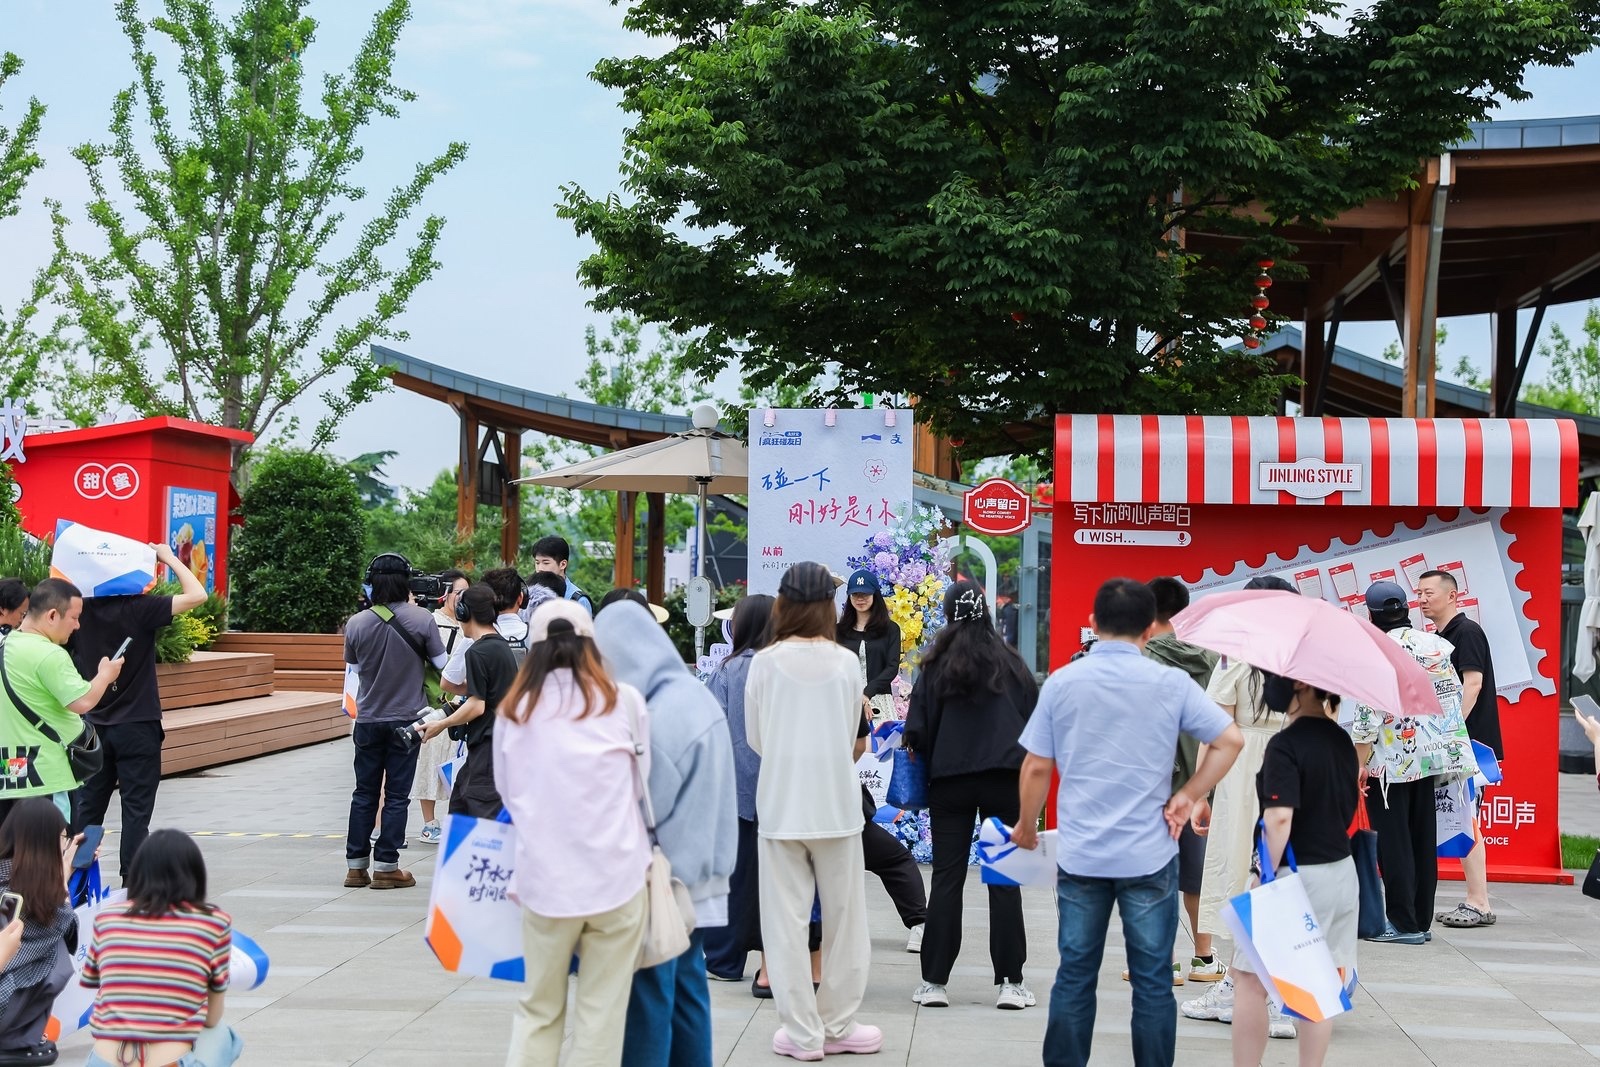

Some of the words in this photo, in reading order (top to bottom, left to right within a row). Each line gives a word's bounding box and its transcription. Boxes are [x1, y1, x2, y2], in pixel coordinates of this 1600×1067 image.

[83, 472, 132, 492] 甜蜜
[762, 467, 831, 492] 碰一下
[1268, 468, 1315, 483] JINLING
[1317, 469, 1353, 484] STYLE
[788, 496, 897, 527] 刚好是你
[974, 497, 1020, 511] 心声留白
[1073, 503, 1191, 526] 写下你的心声留白
[1081, 531, 1085, 542] I
[1089, 531, 1136, 544] WISH...
[762, 546, 783, 556] 从前
